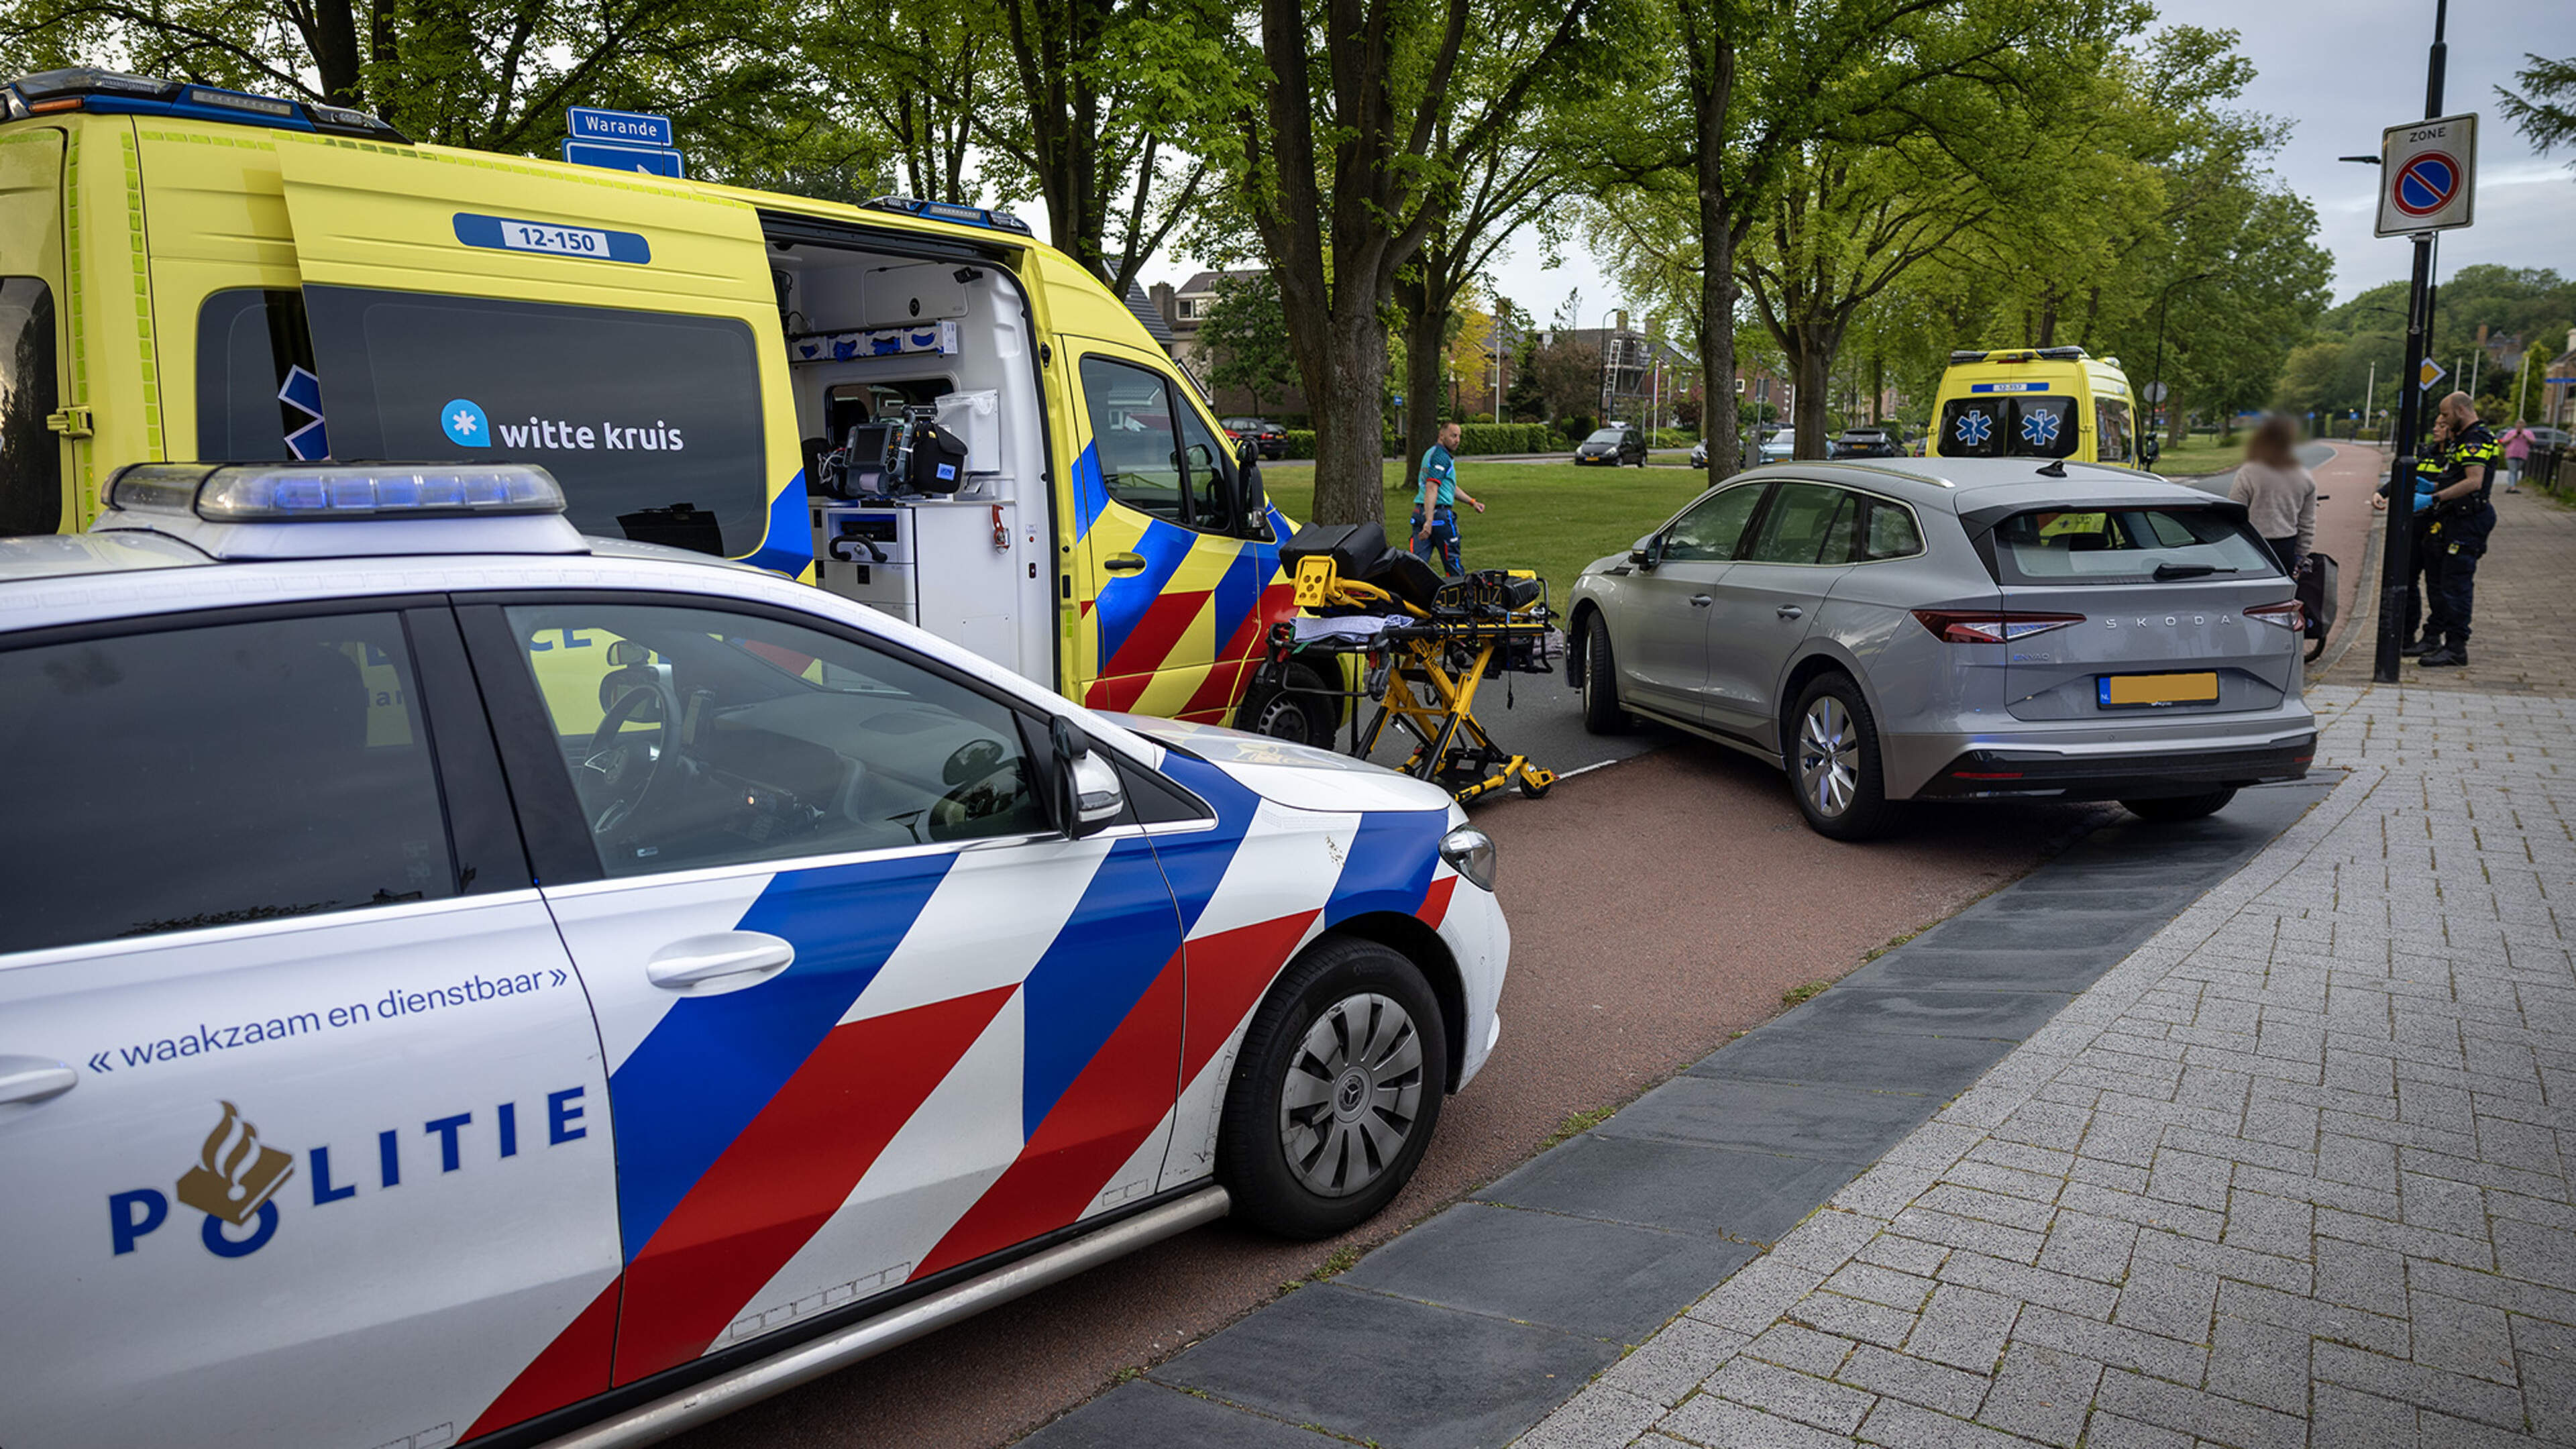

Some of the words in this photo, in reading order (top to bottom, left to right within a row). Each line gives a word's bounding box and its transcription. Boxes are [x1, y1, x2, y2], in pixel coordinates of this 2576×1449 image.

[585, 115, 657, 138] Warande
[2409, 126, 2447, 143] ZONE
[518, 227, 596, 253] 12-150
[498, 417, 596, 449] witte
[602, 420, 684, 451] kruis
[2105, 614, 2231, 629] SKODA
[119, 1012, 321, 1068] waakzaam
[327, 1003, 371, 1028] en
[376, 971, 543, 1019] dienstbaar
[109, 1085, 587, 1258] POLITIE
